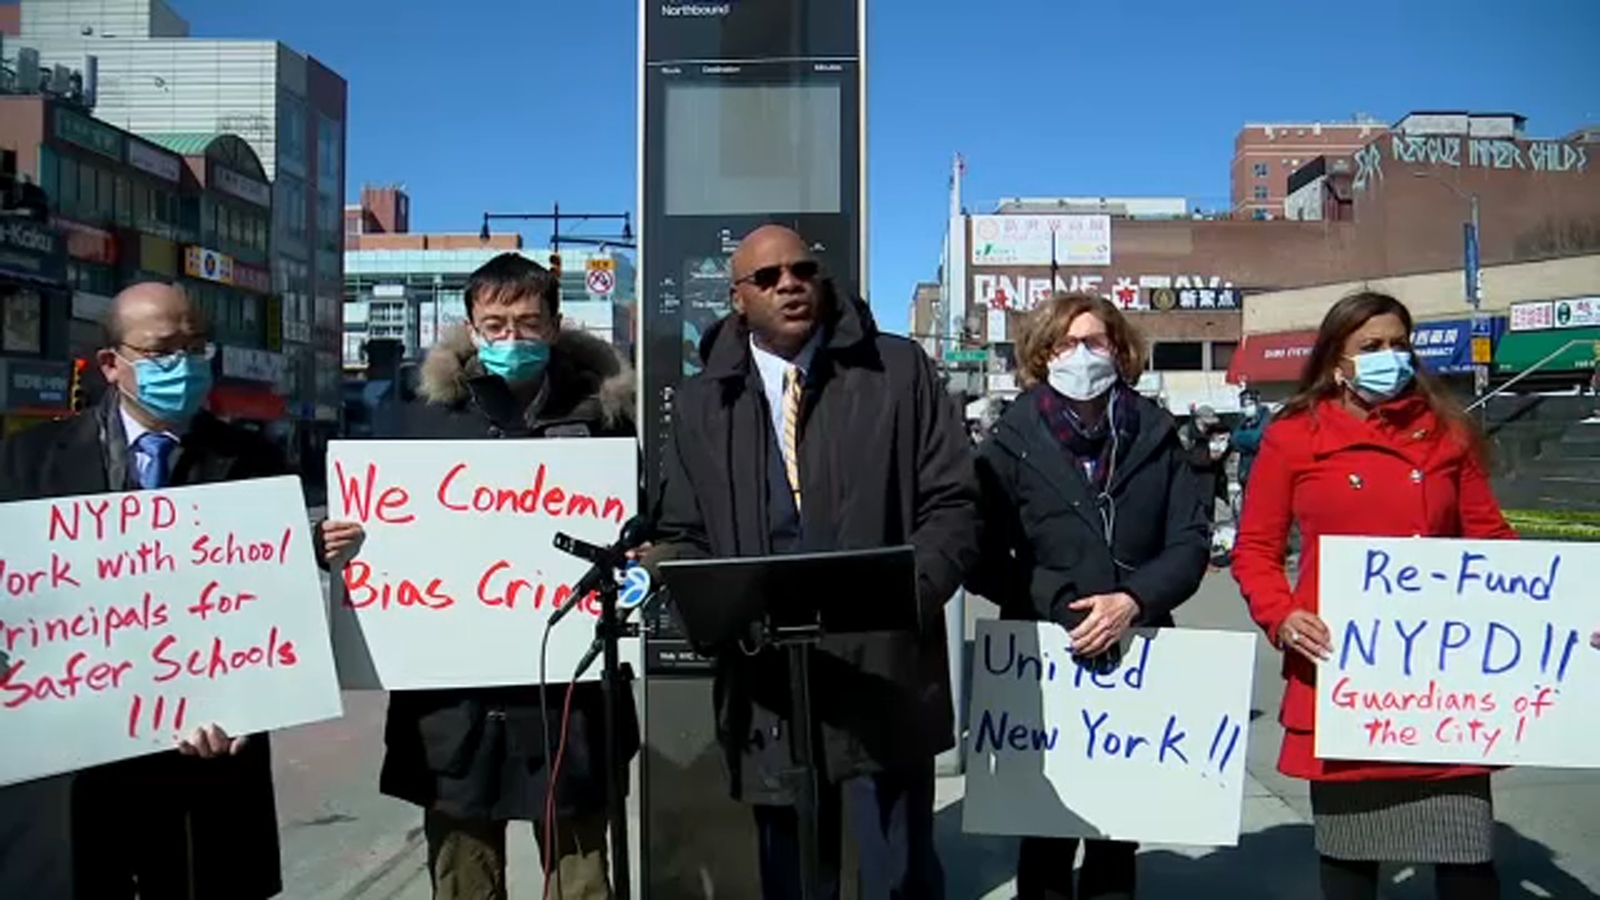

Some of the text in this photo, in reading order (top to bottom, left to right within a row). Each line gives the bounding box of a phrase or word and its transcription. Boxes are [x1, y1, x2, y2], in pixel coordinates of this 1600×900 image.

[661, 4, 729, 17] Northbound
[335, 461, 625, 523] We Condemn
[0, 528, 291, 596] ork with School
[342, 560, 455, 610] Bias
[1363, 548, 1561, 601] Re-Fund
[188, 580, 257, 620] for
[0, 626, 298, 708] Safer Schools
[1331, 677, 1555, 718] Guardians of
[975, 708, 1058, 753] New
[1364, 718, 1420, 746] the
